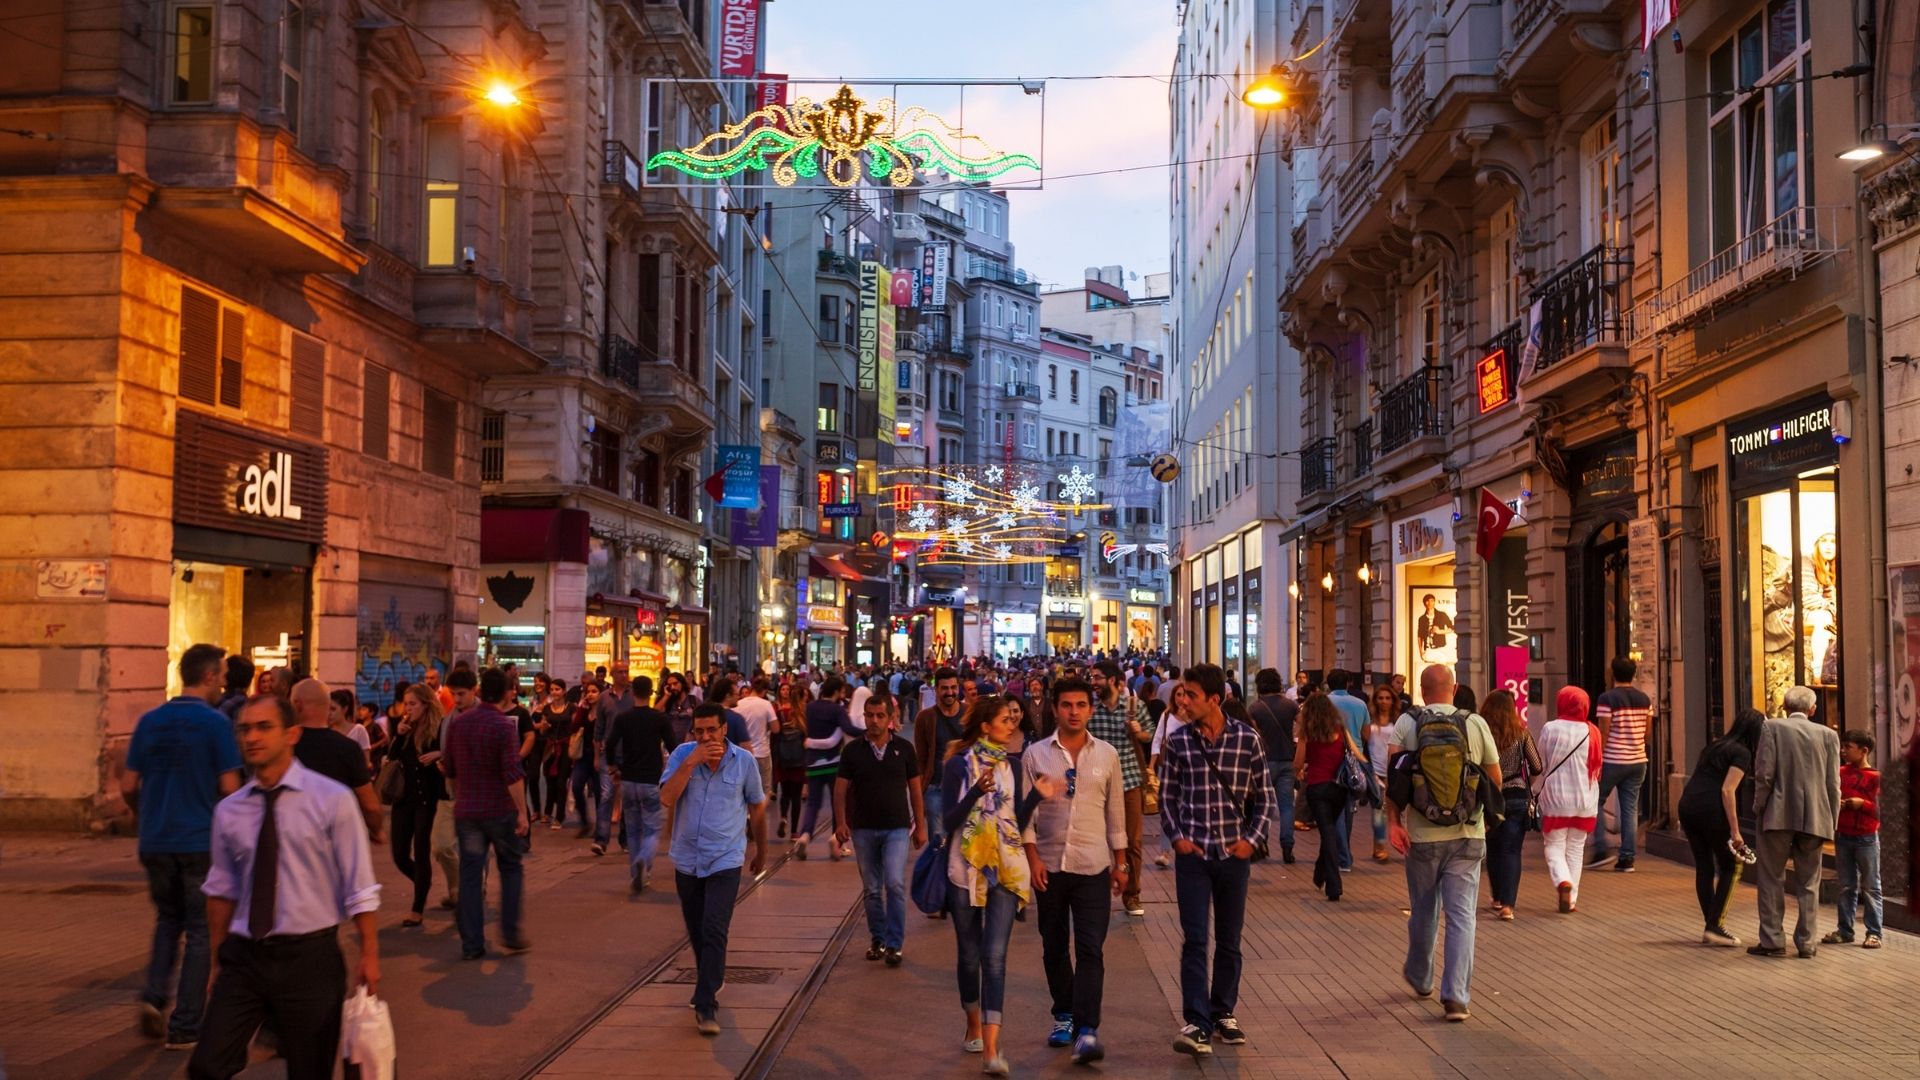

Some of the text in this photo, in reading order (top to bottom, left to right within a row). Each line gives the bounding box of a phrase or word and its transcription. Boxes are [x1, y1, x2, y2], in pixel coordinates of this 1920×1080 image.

[935, 248, 946, 304] SÜRÜCÜ KURSU
[859, 264, 878, 390] ENGLISH TIME
[1730, 408, 1831, 455] TOMMY HILFIGER
[243, 451, 302, 520] adL
[1399, 518, 1424, 555] LTB
